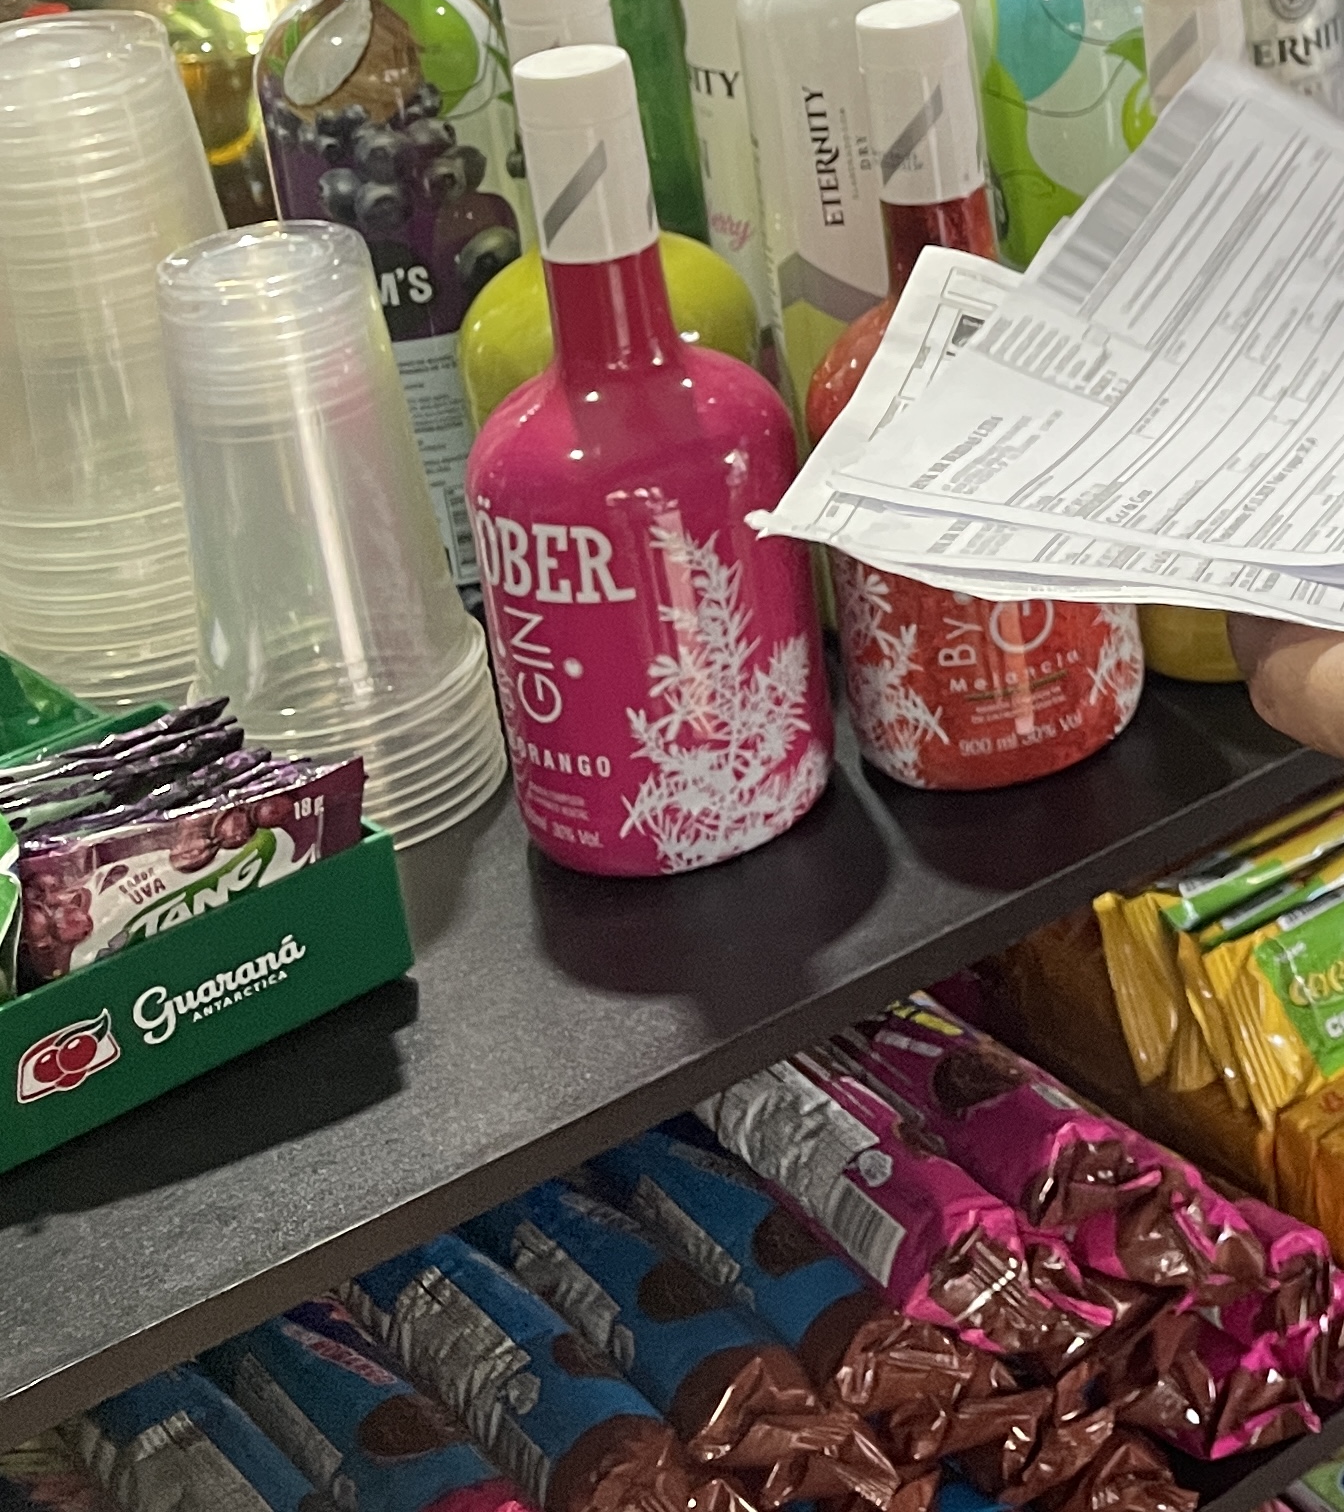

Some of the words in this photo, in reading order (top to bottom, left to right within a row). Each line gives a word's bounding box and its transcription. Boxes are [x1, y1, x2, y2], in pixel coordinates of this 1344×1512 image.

[802, 86, 846, 228] ETERNITY
[505, 605, 563, 724] GIN
[938, 617, 984, 668] BY
[950, 649, 1080, 692] Melancia
[959, 738, 992, 756] 900
[128, 848, 263, 938] TANG
[129, 877, 167, 906] UVA
[132, 934, 306, 1044] Guaraná
[191, 970, 288, 1024] ANTARCTICA
